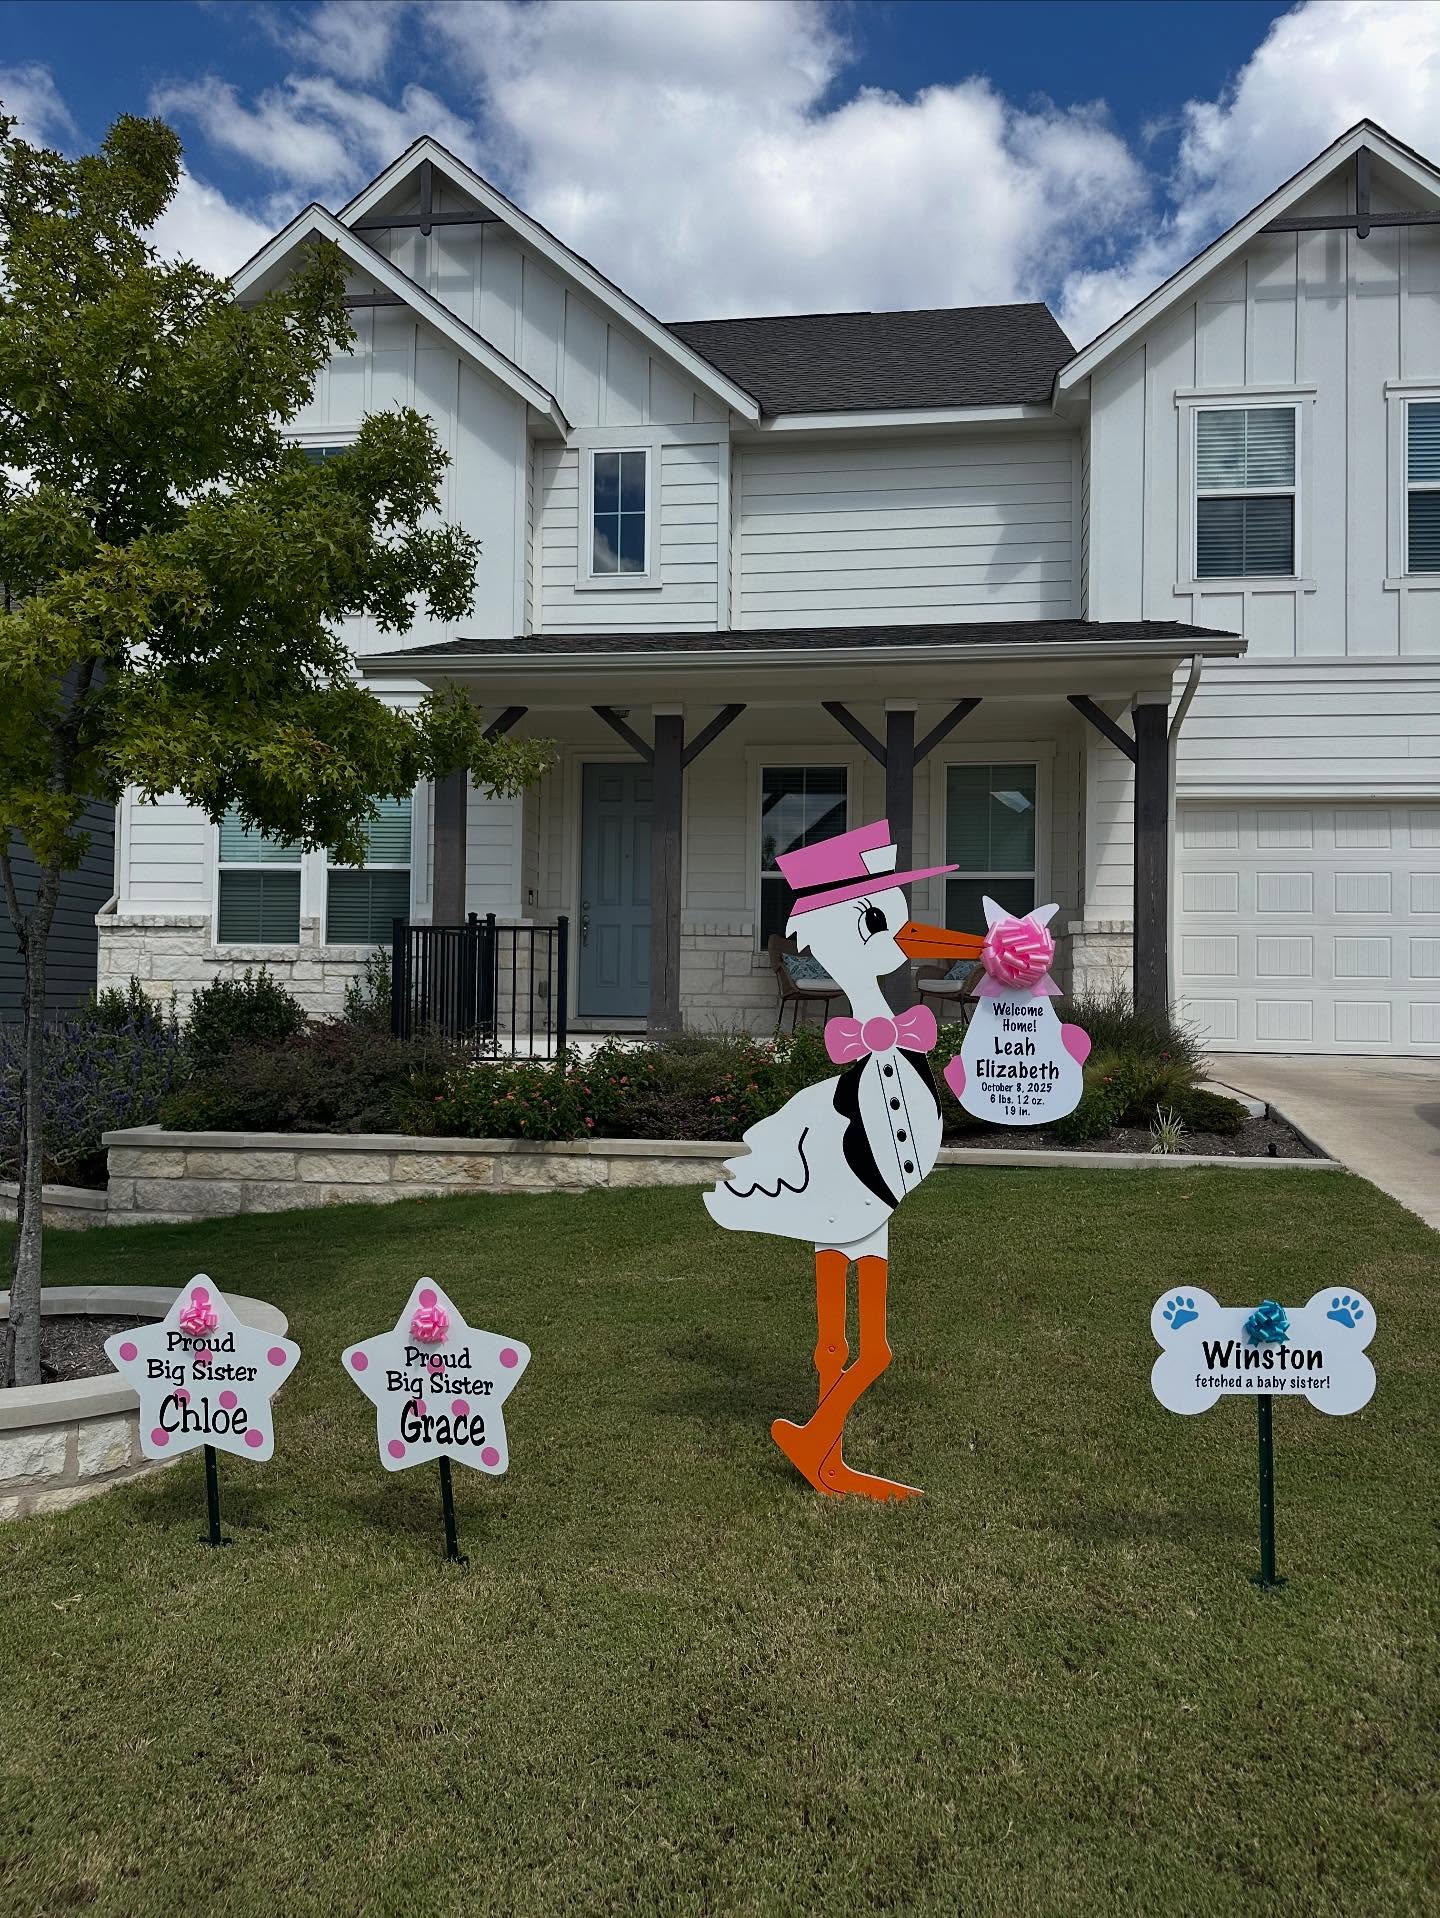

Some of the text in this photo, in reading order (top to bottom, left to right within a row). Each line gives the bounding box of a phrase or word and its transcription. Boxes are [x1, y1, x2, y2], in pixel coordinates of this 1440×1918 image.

[993, 1003, 1044, 1017] Welcome
[1003, 1019, 1037, 1032] Home!
[994, 1036, 1035, 1056] Leah
[976, 1059, 1059, 1079] Elizabeth
[981, 1082, 1052, 1093] October 8, 2025
[990, 1094, 1045, 1105] 6 lbs. 12 oz.
[1005, 1106, 1031, 1116] 19 in.
[167, 1332, 236, 1353] Proud
[404, 1346, 472, 1369] Proud
[1202, 1340, 1323, 1370] Winston
[147, 1359, 257, 1386] Big Sister
[1195, 1374, 1330, 1390] fetched a baby sister!
[386, 1371, 493, 1400] Big Sister
[159, 1394, 248, 1434] Chloe
[401, 1400, 486, 1446] Grace
